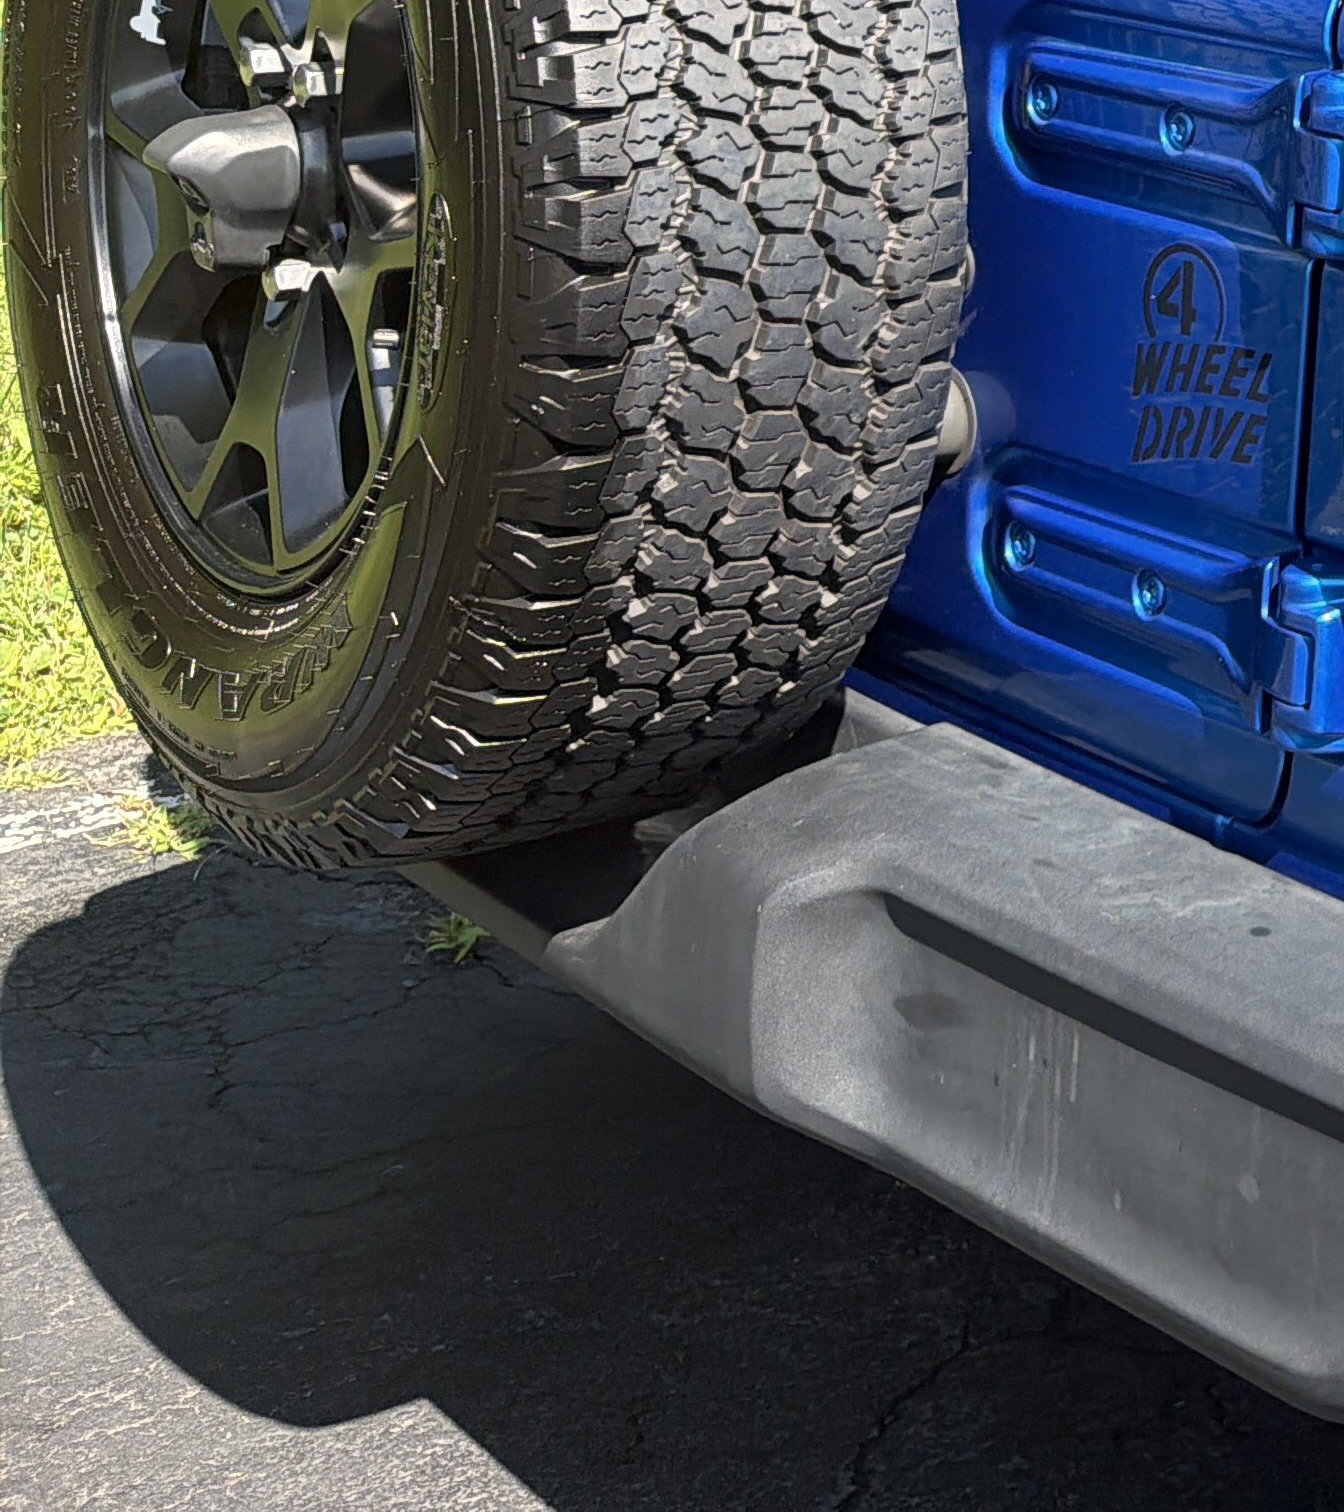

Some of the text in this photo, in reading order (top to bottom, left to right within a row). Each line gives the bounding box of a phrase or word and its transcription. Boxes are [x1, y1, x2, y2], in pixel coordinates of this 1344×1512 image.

[1155, 259, 1197, 337] 4
[1131, 342, 1273, 403] WHEEL
[1131, 404, 1269, 464] DRIVE
